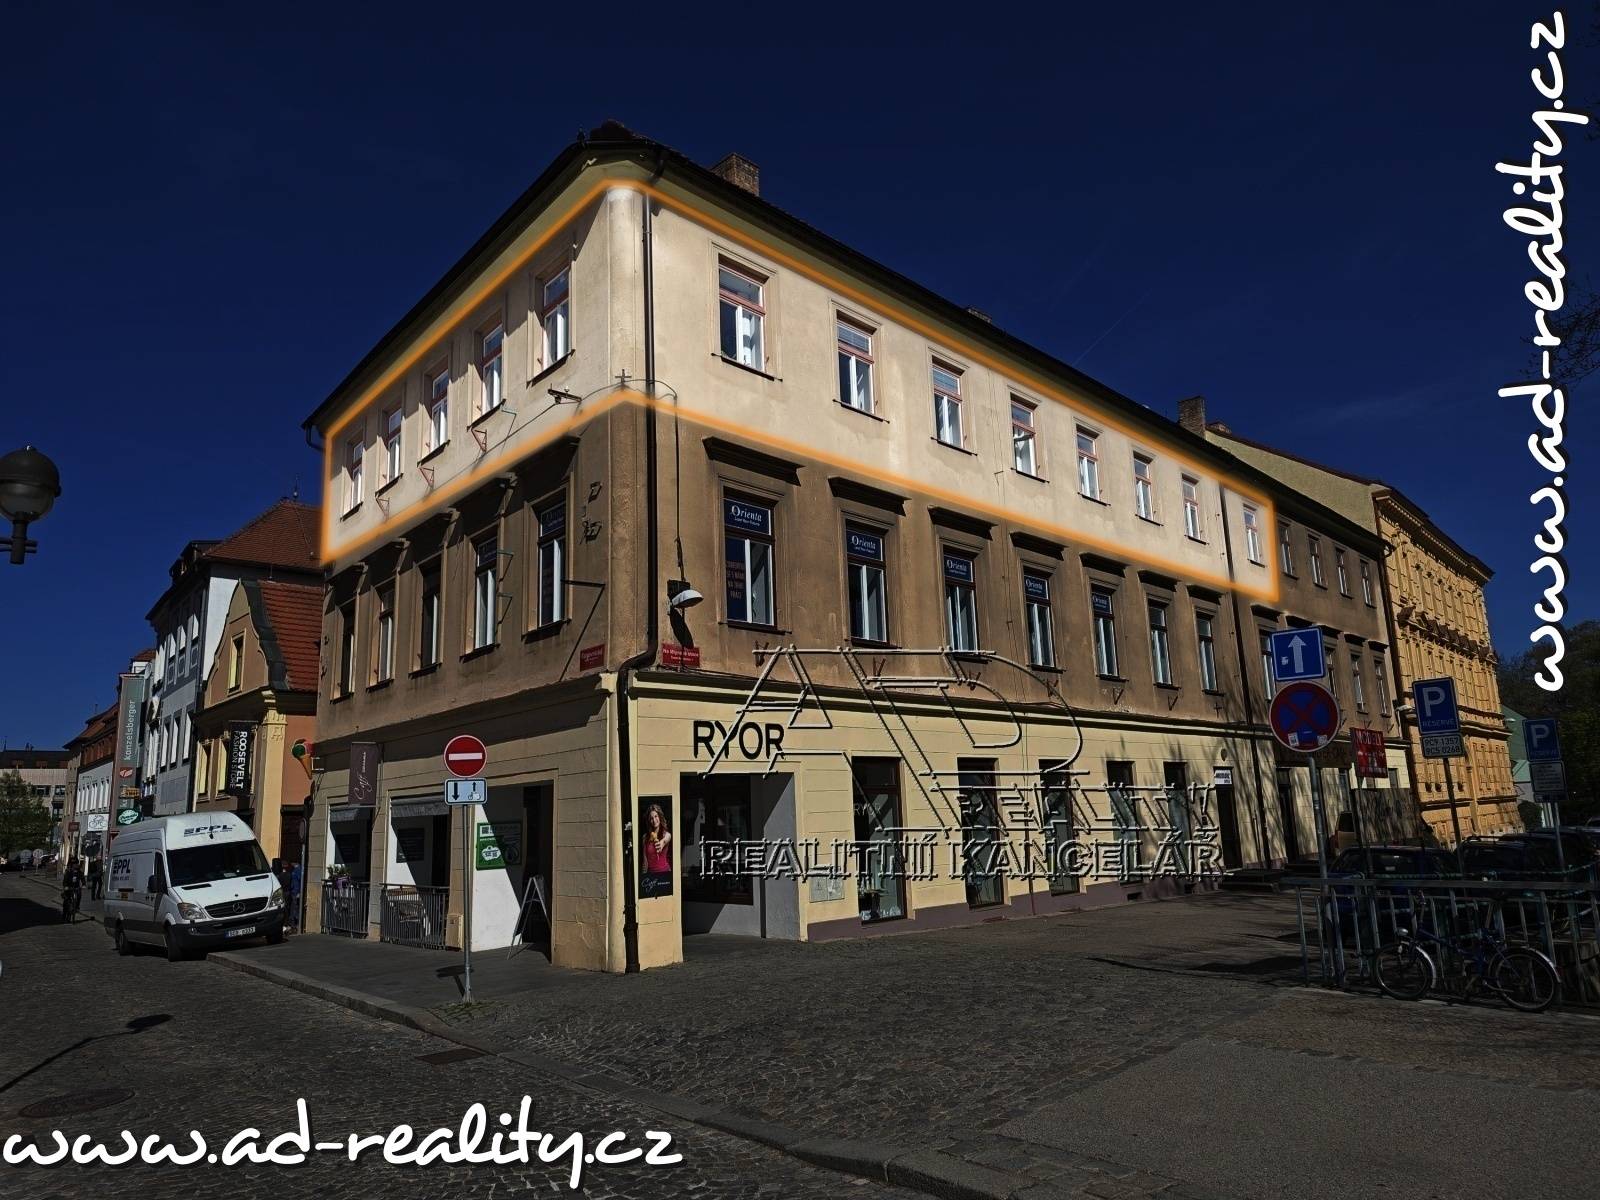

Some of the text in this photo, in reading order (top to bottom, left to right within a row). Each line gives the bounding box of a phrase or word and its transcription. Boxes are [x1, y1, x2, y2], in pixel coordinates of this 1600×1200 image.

[1422, 686, 1446, 718] P
[123, 700, 137, 761] kanzelsberger
[231, 730, 241, 763] FASHION
[693, 720, 785, 760] RYOR
[1531, 724, 1551, 749] P
[235, 731, 248, 790] ROOSEVELT
